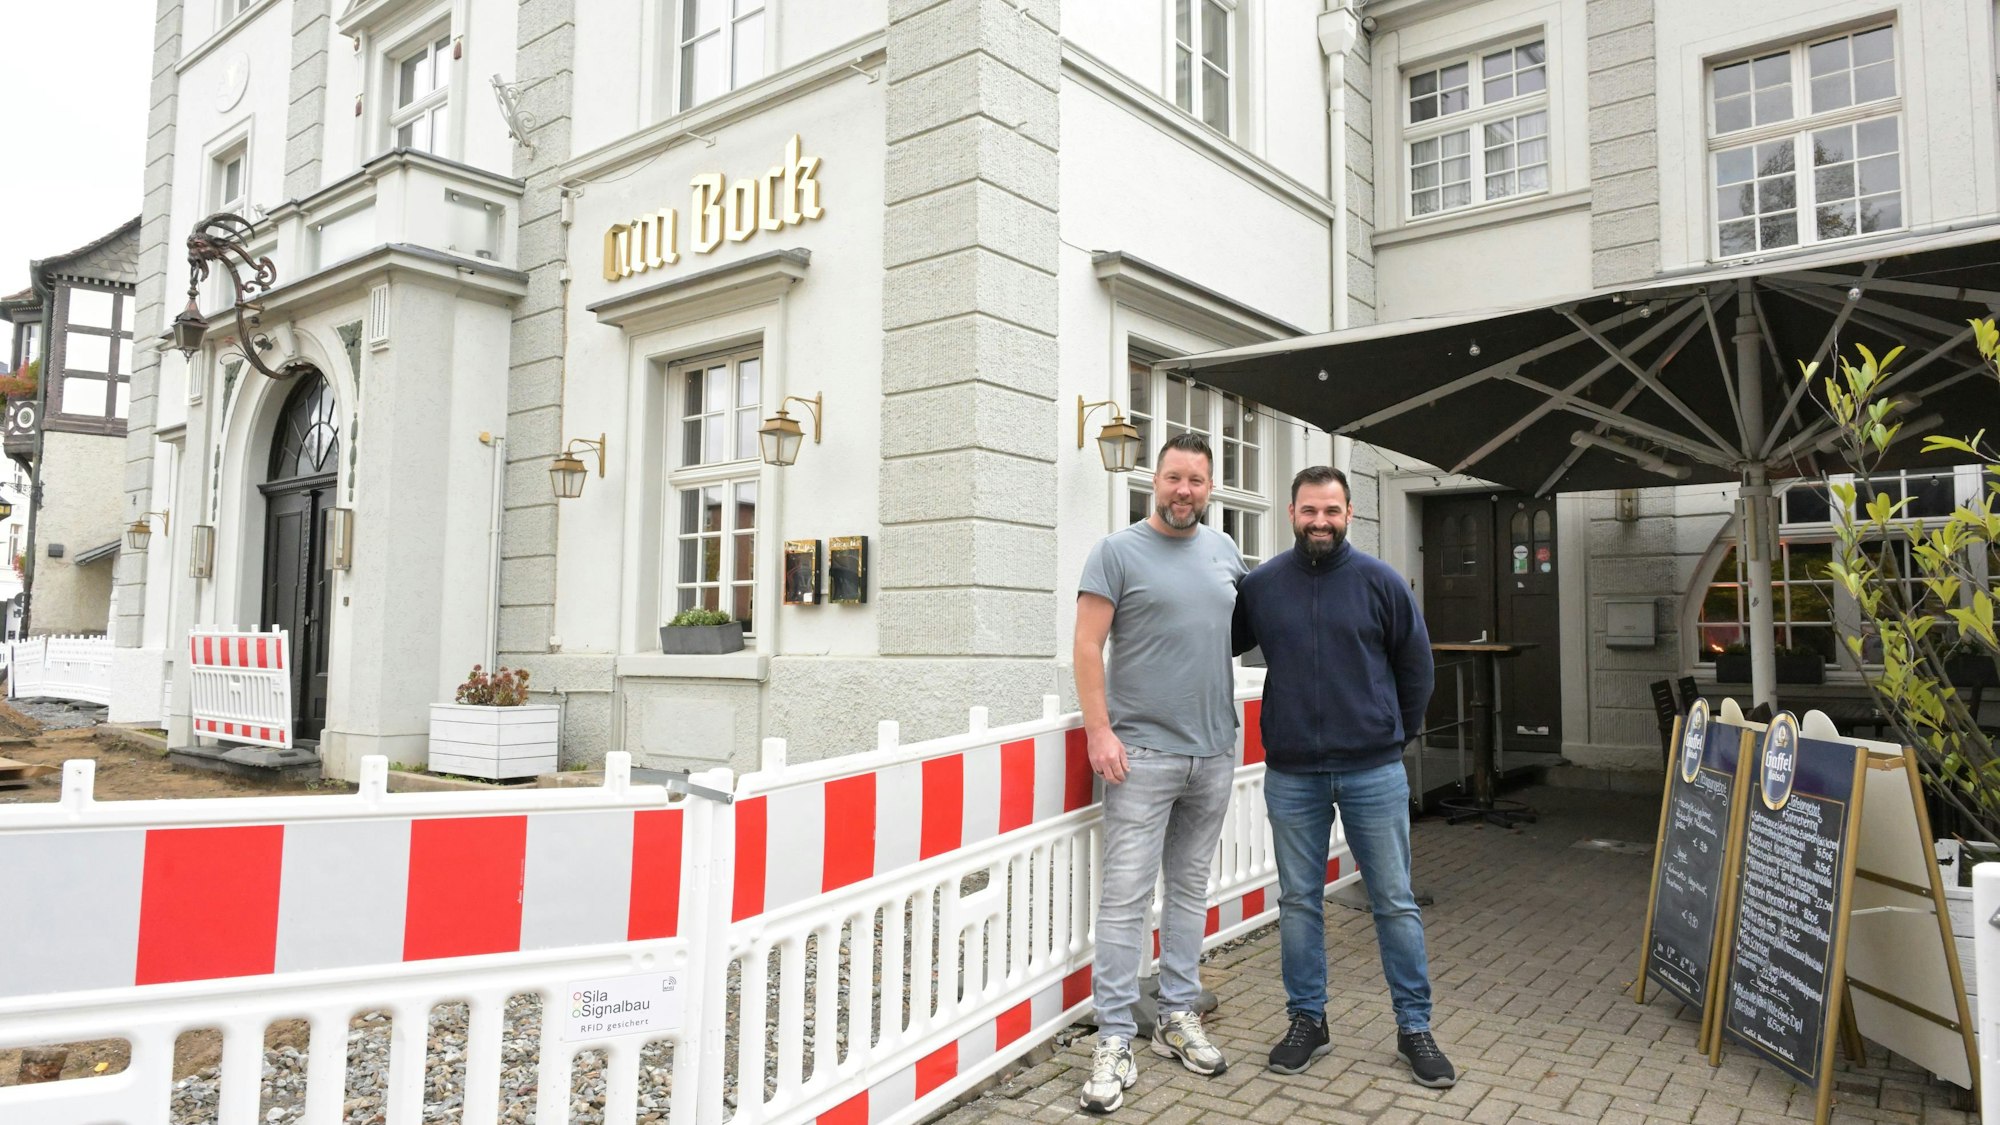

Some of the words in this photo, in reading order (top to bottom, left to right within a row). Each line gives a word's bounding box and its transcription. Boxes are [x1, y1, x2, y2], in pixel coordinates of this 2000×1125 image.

[689, 133, 825, 254] Bock
[1685, 732, 1703, 750] Gaffel
[1765, 750, 1793, 772] Gaffel
[1767, 769, 1786, 784] Kölsch
[582, 990, 608, 1003] Sila
[581, 1000, 650, 1019] Signalbau
[580, 1023, 603, 1033] RFID
[607, 1019, 649, 1031] gesichert
